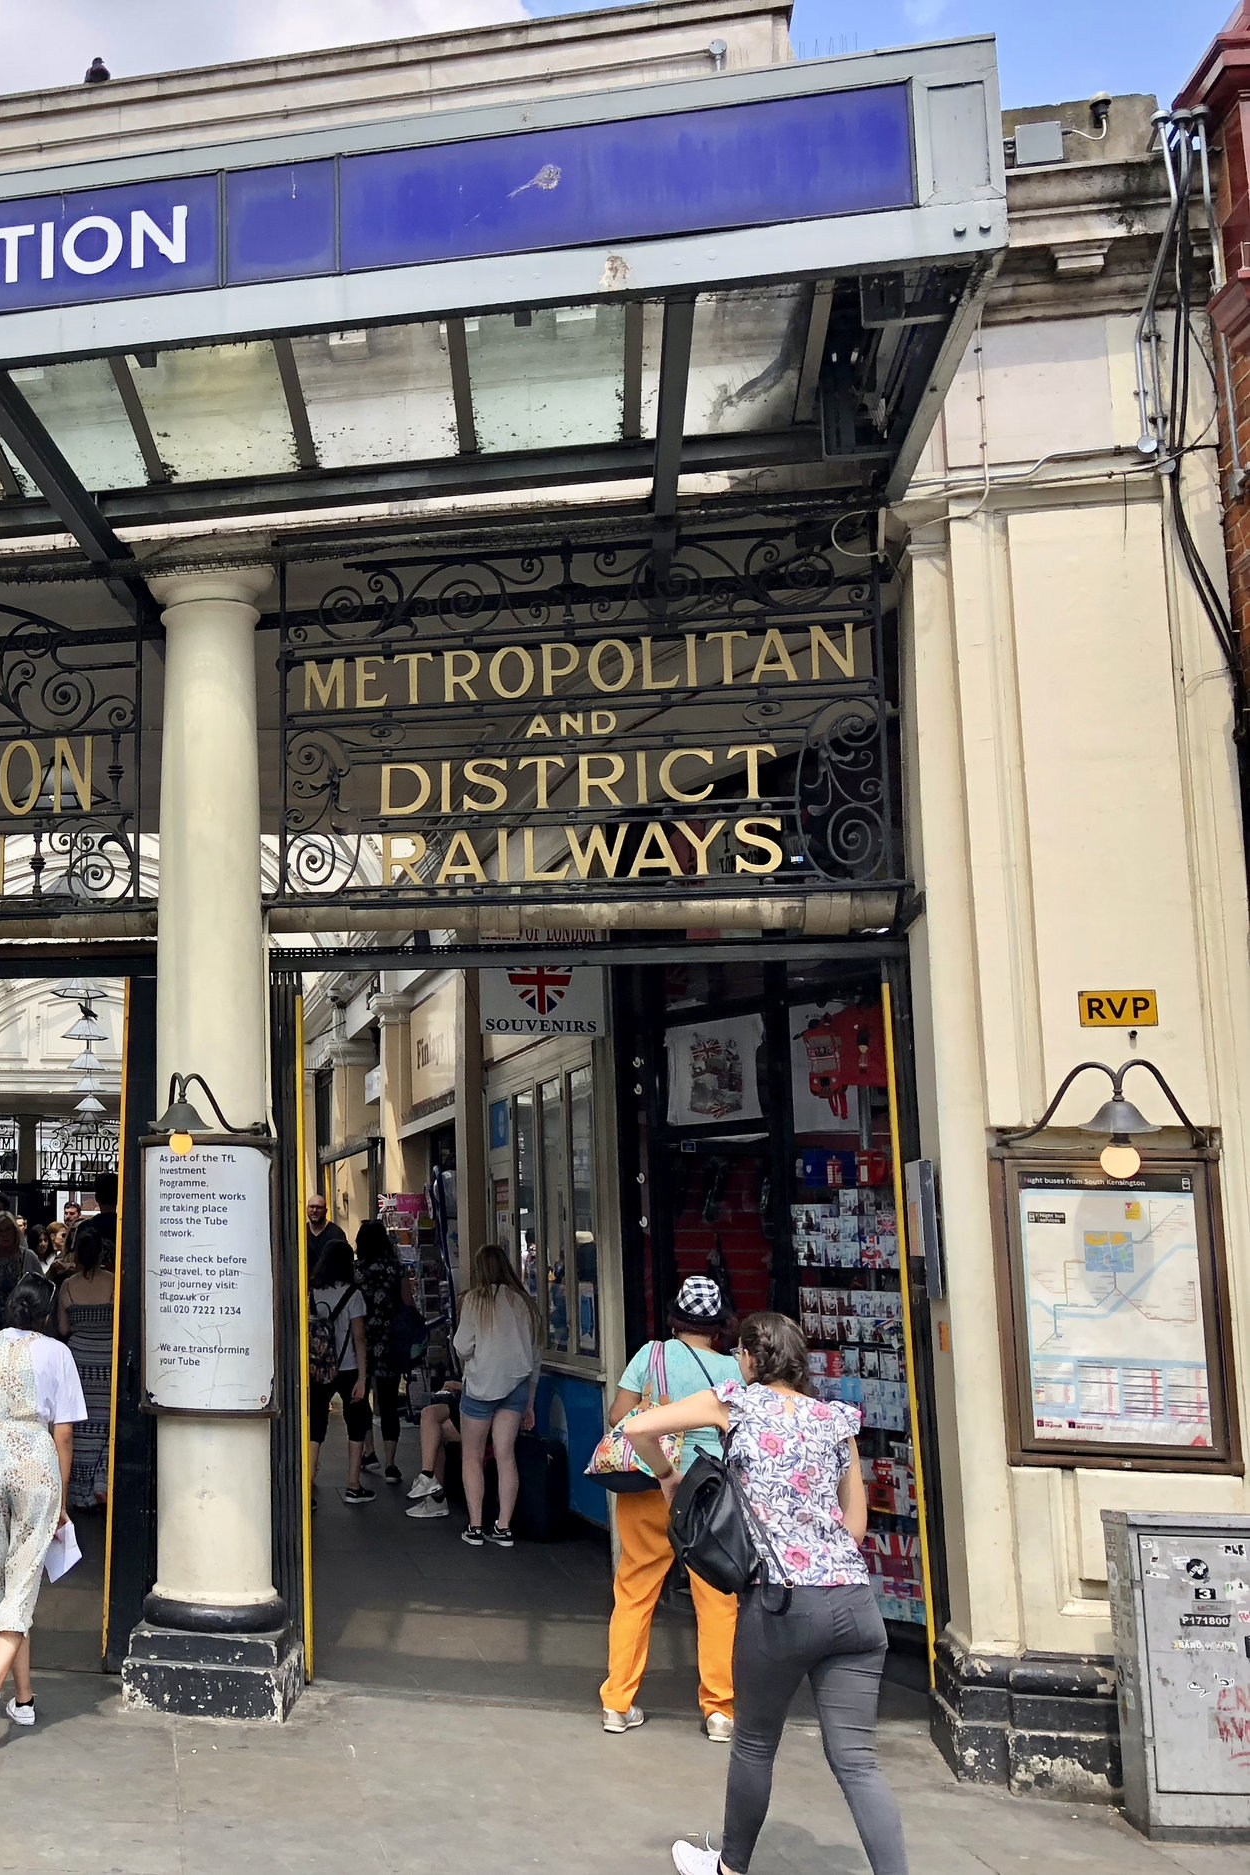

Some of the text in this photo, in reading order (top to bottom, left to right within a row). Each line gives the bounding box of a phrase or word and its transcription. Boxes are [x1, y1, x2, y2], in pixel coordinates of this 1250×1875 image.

[302, 622, 857, 711] METROPOLITAN
[525, 709, 617, 738] AND
[378, 743, 778, 817] DISTRICT
[380, 816, 783, 886] RAILWAYS
[1086, 996, 1150, 1020] RVP
[485, 1018, 597, 1033] SOUVENIRS
[159, 1154, 237, 1164] As part of the TfL
[159, 1167, 207, 1175] Investment
[159, 1179, 209, 1188] Programme,
[1044, 1177, 1064, 1185] buses
[1066, 1177, 1083, 1185] from
[1084, 1178, 1105, 1186] South
[1106, 1179, 1146, 1187] Kensington
[159, 1192, 247, 1201] improvement works
[172, 1204, 199, 1213] taking
[202, 1204, 228, 1214] place
[159, 1216, 228, 1226] across the Tube
[159, 1229, 195, 1238] network.
[159, 1254, 247, 1264] Please check before
[159, 1268, 172, 1277] you
[205, 1268, 216, 1276] to
[219, 1268, 240, 1278] plan
[159, 1280, 238, 1291] your journey visit:
[159, 1304, 241, 1315] call 020 7222 1234
[160, 1343, 250, 1356] We are transforming
[159, 1357, 200, 1366] your Tube
[1198, 1588, 1212, 1599] 3
[1181, 1615, 1230, 1626] P171800
